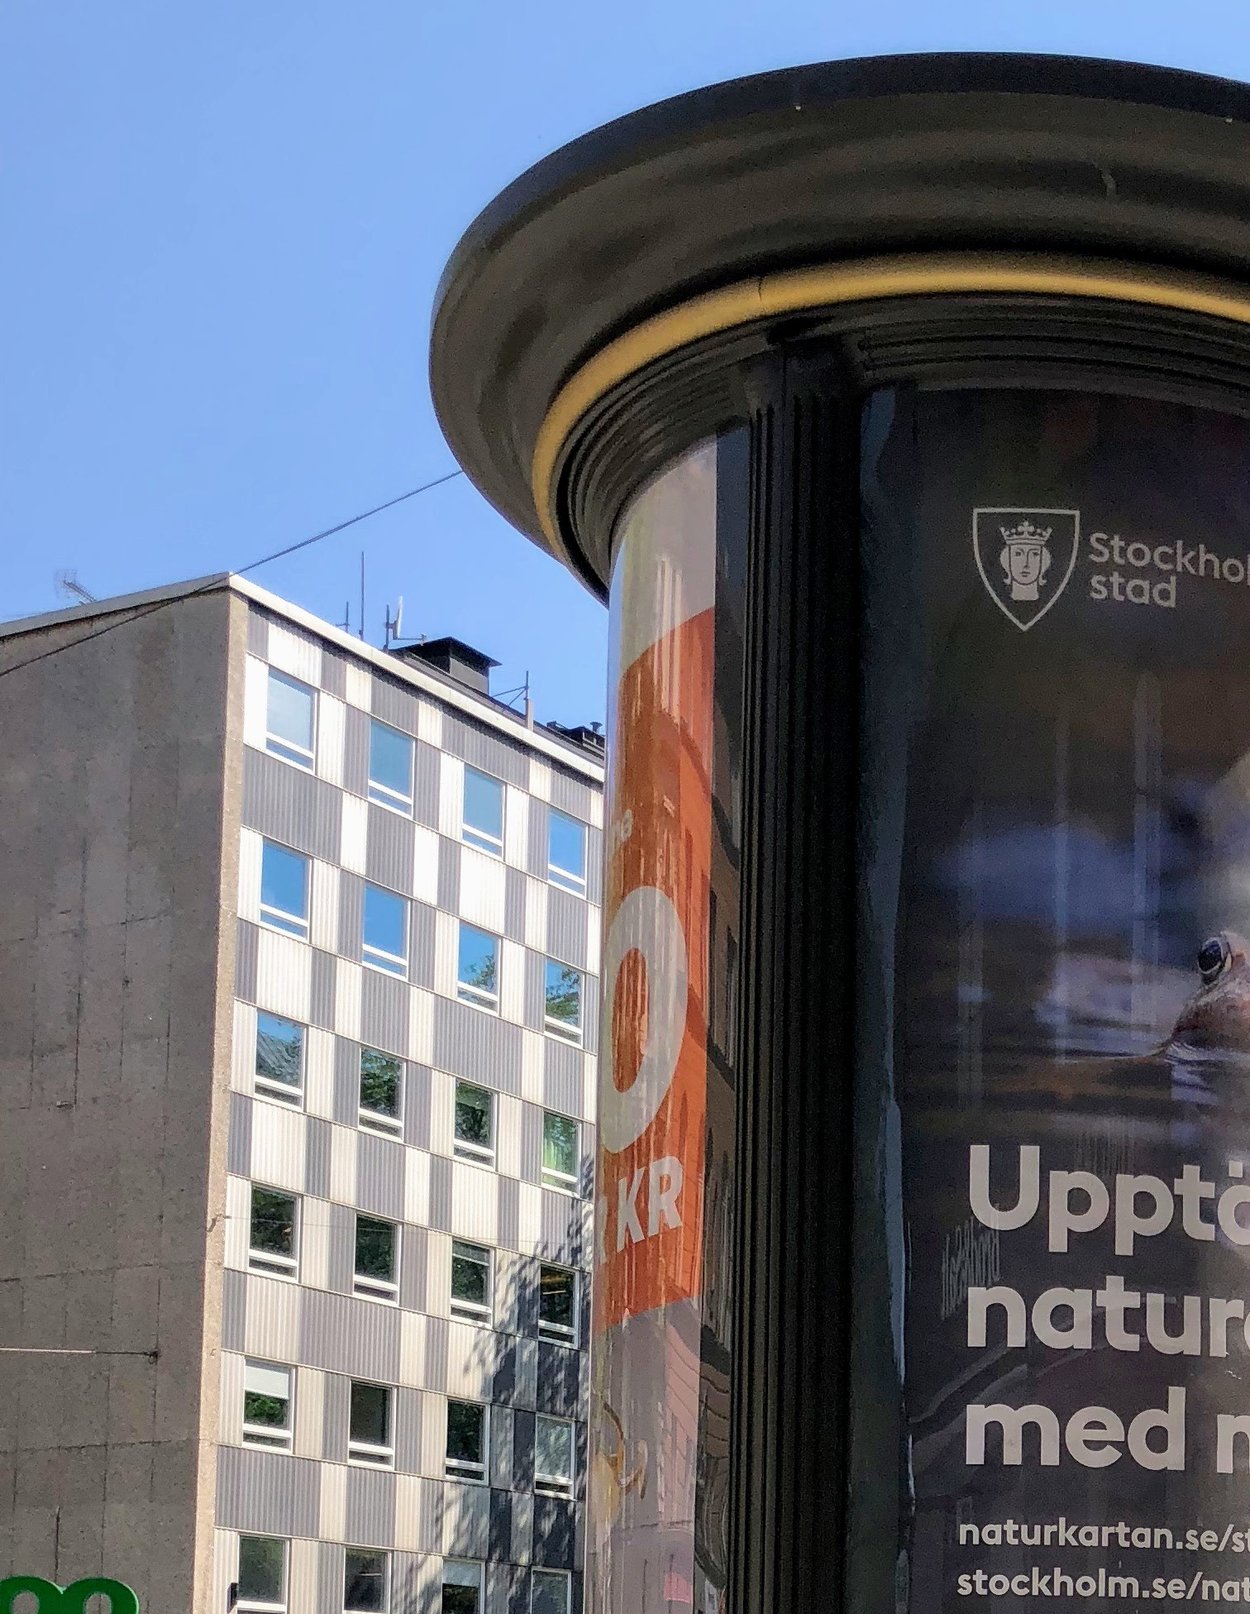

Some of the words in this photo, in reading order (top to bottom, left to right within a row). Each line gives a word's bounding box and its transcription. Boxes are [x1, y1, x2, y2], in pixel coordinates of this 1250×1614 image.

[1090, 576, 1177, 608] stad
[616, 1155, 684, 1254] KR
[965, 1386, 1186, 1471] med
